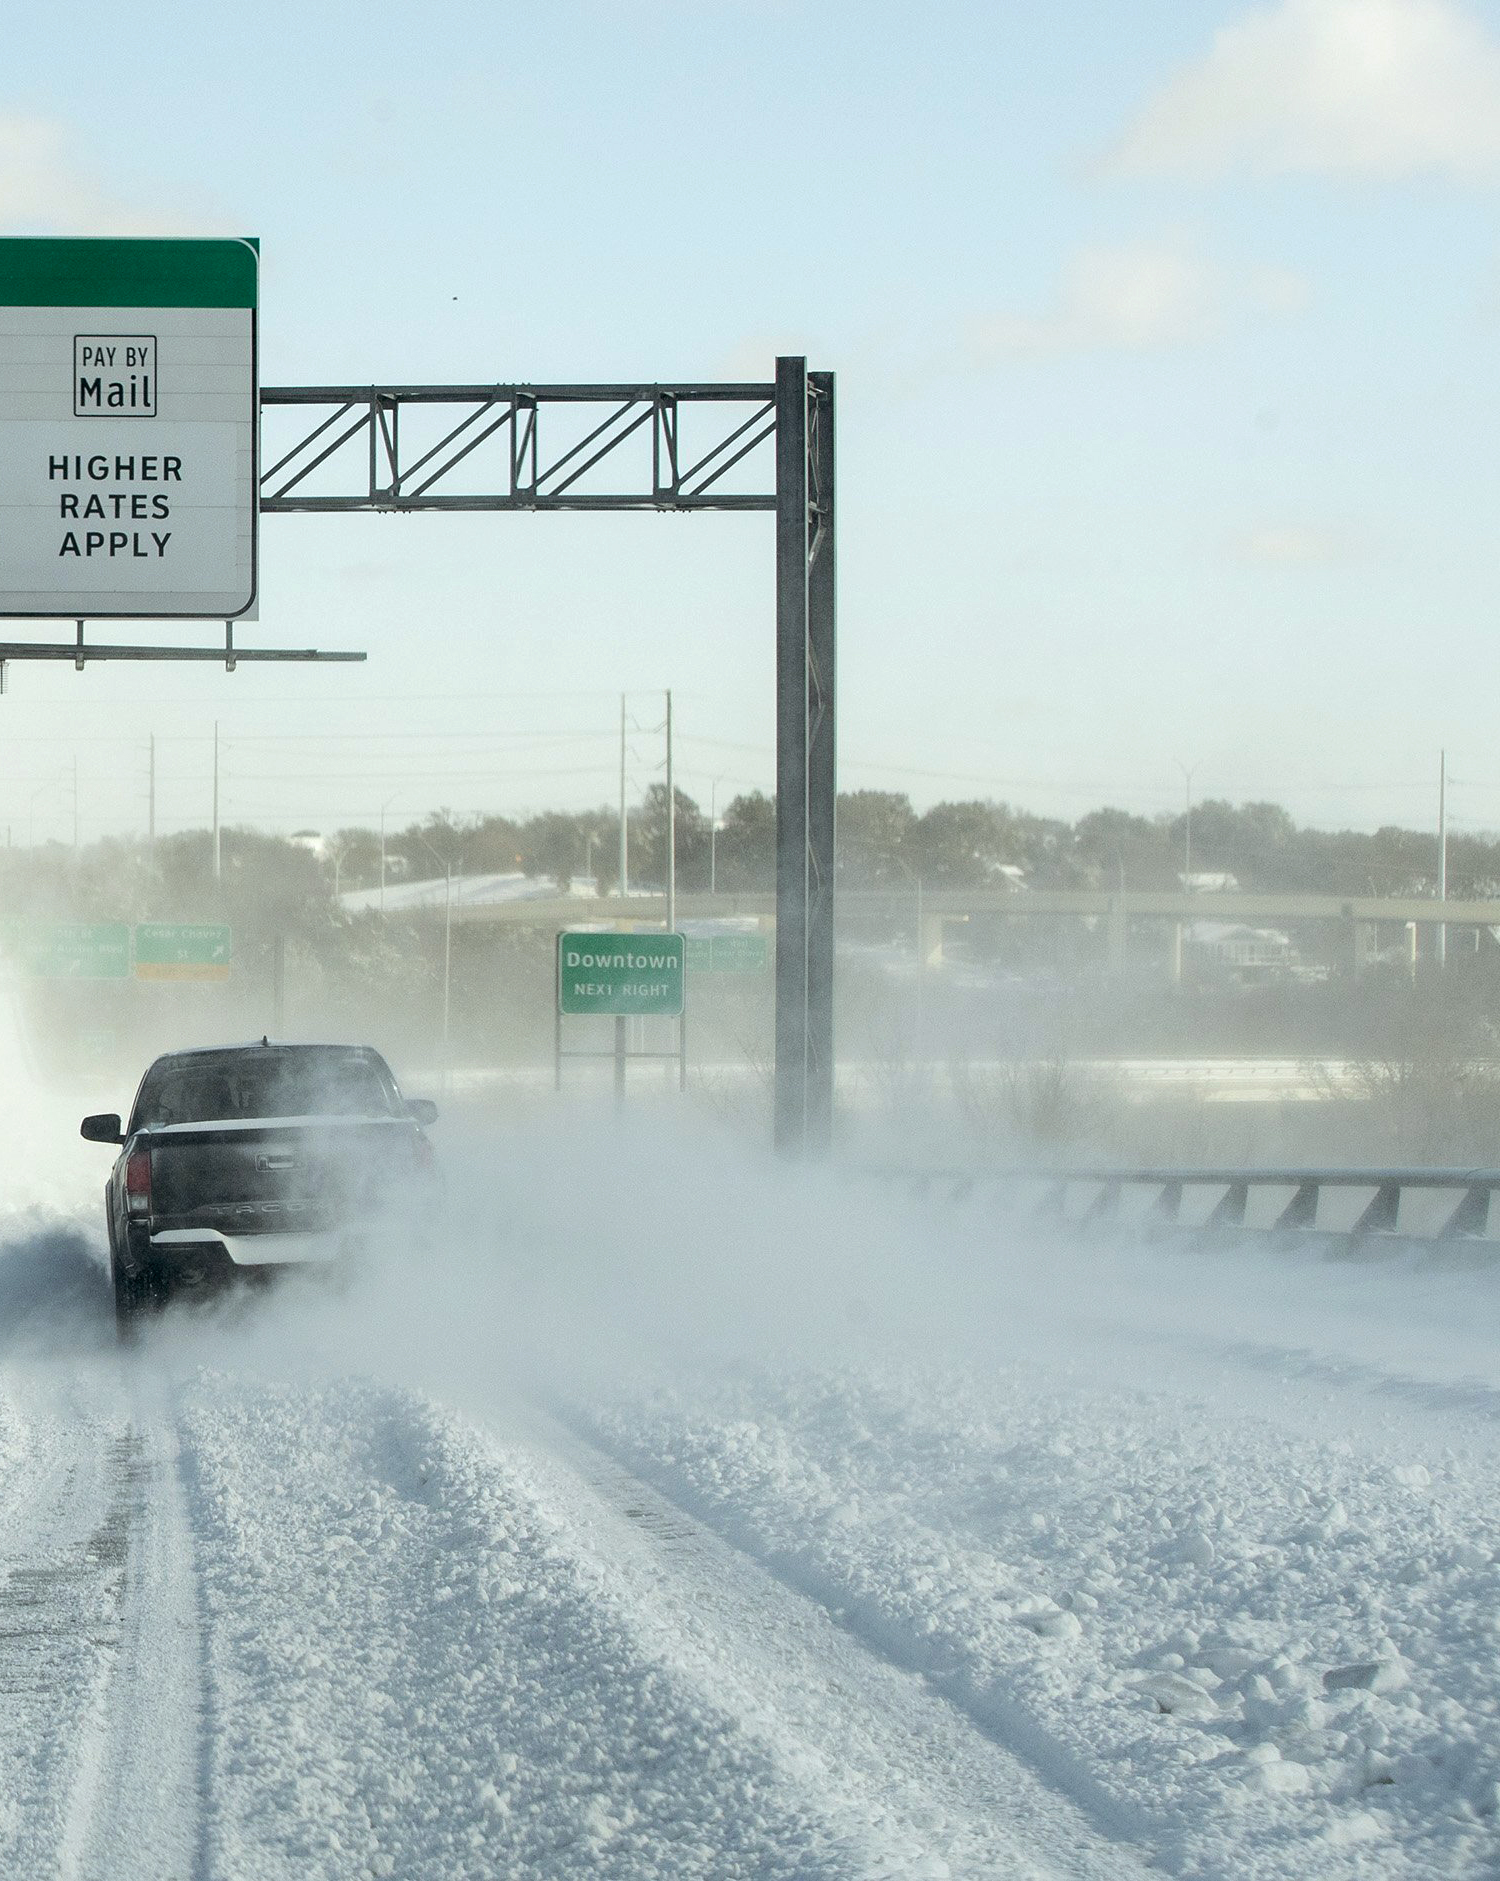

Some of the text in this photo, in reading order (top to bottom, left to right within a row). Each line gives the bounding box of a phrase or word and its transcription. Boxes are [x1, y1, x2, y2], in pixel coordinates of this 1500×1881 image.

[83, 347, 147, 367] PAY BY
[81, 375, 150, 407] Mail
[50, 456, 181, 480] HIGHER
[61, 494, 169, 519] RATES
[60, 532, 170, 556] APPLY
[567, 952, 678, 969] Downtown
[575, 983, 668, 997] NEXT RIGHT
